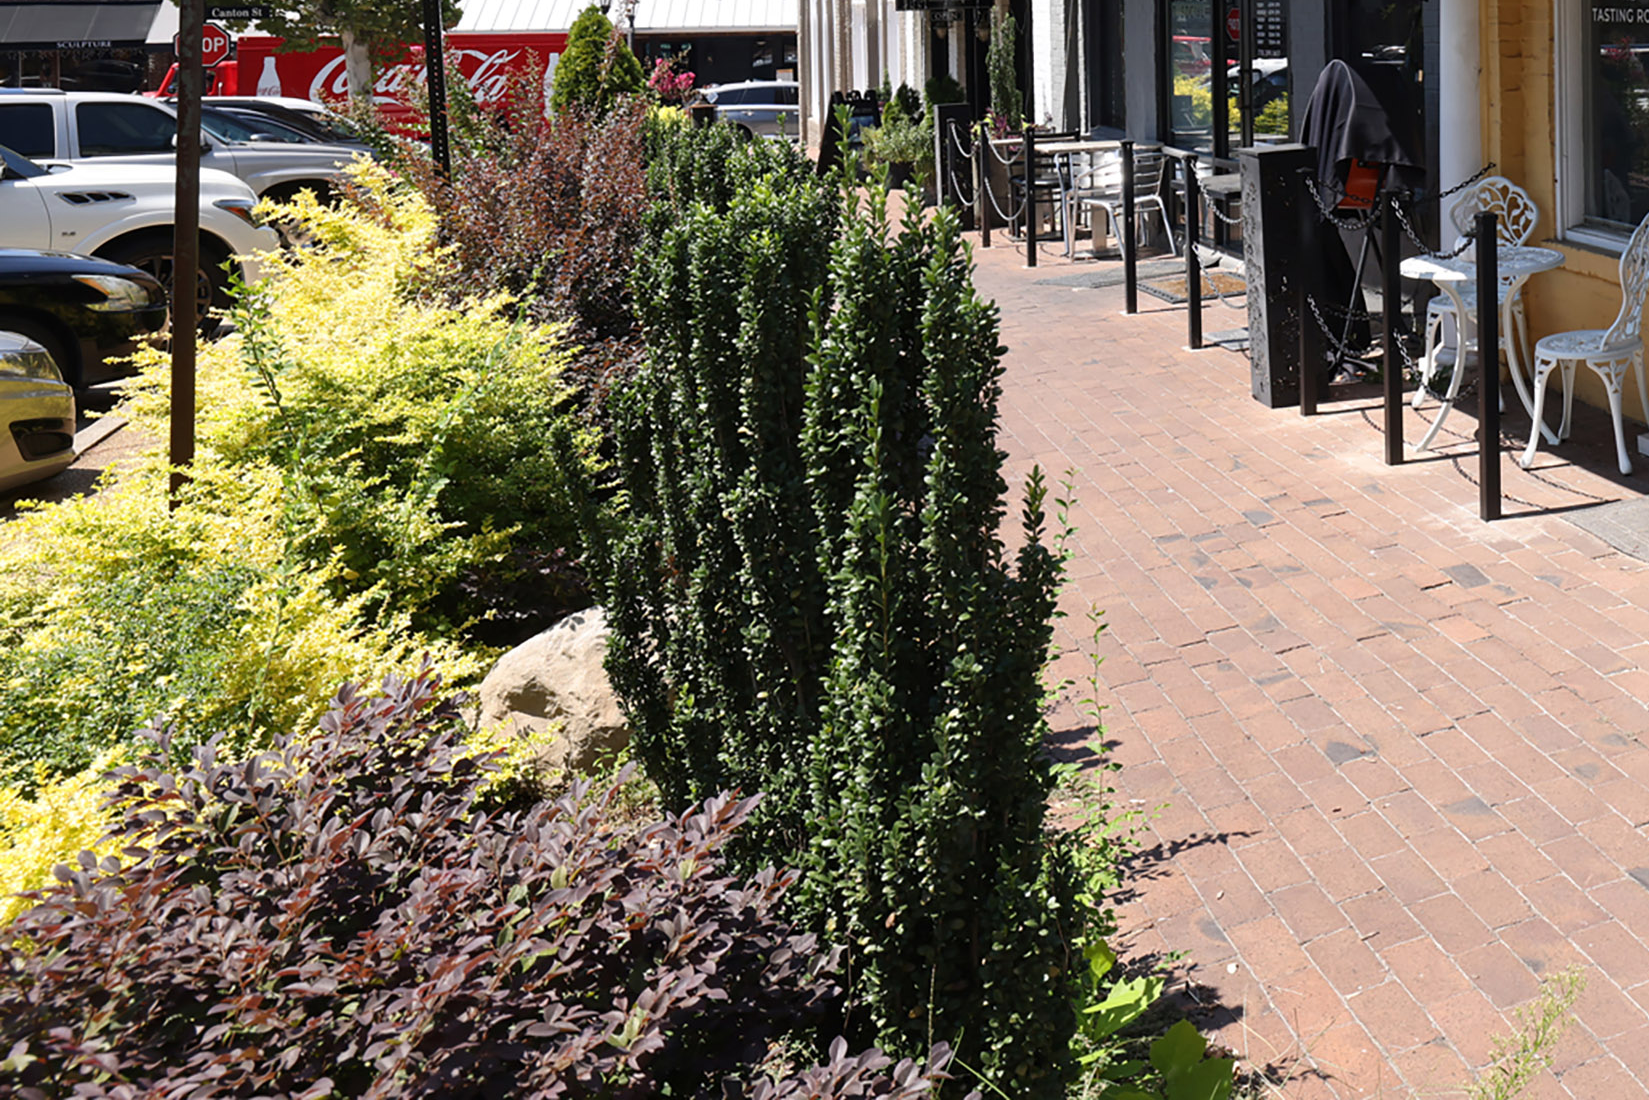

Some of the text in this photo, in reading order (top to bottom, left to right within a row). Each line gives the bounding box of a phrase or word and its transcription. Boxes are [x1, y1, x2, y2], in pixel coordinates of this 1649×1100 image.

[212, 8, 262, 17] Canton St
[1592, 8, 1634, 23] TASTING
[202, 37, 225, 53] OP
